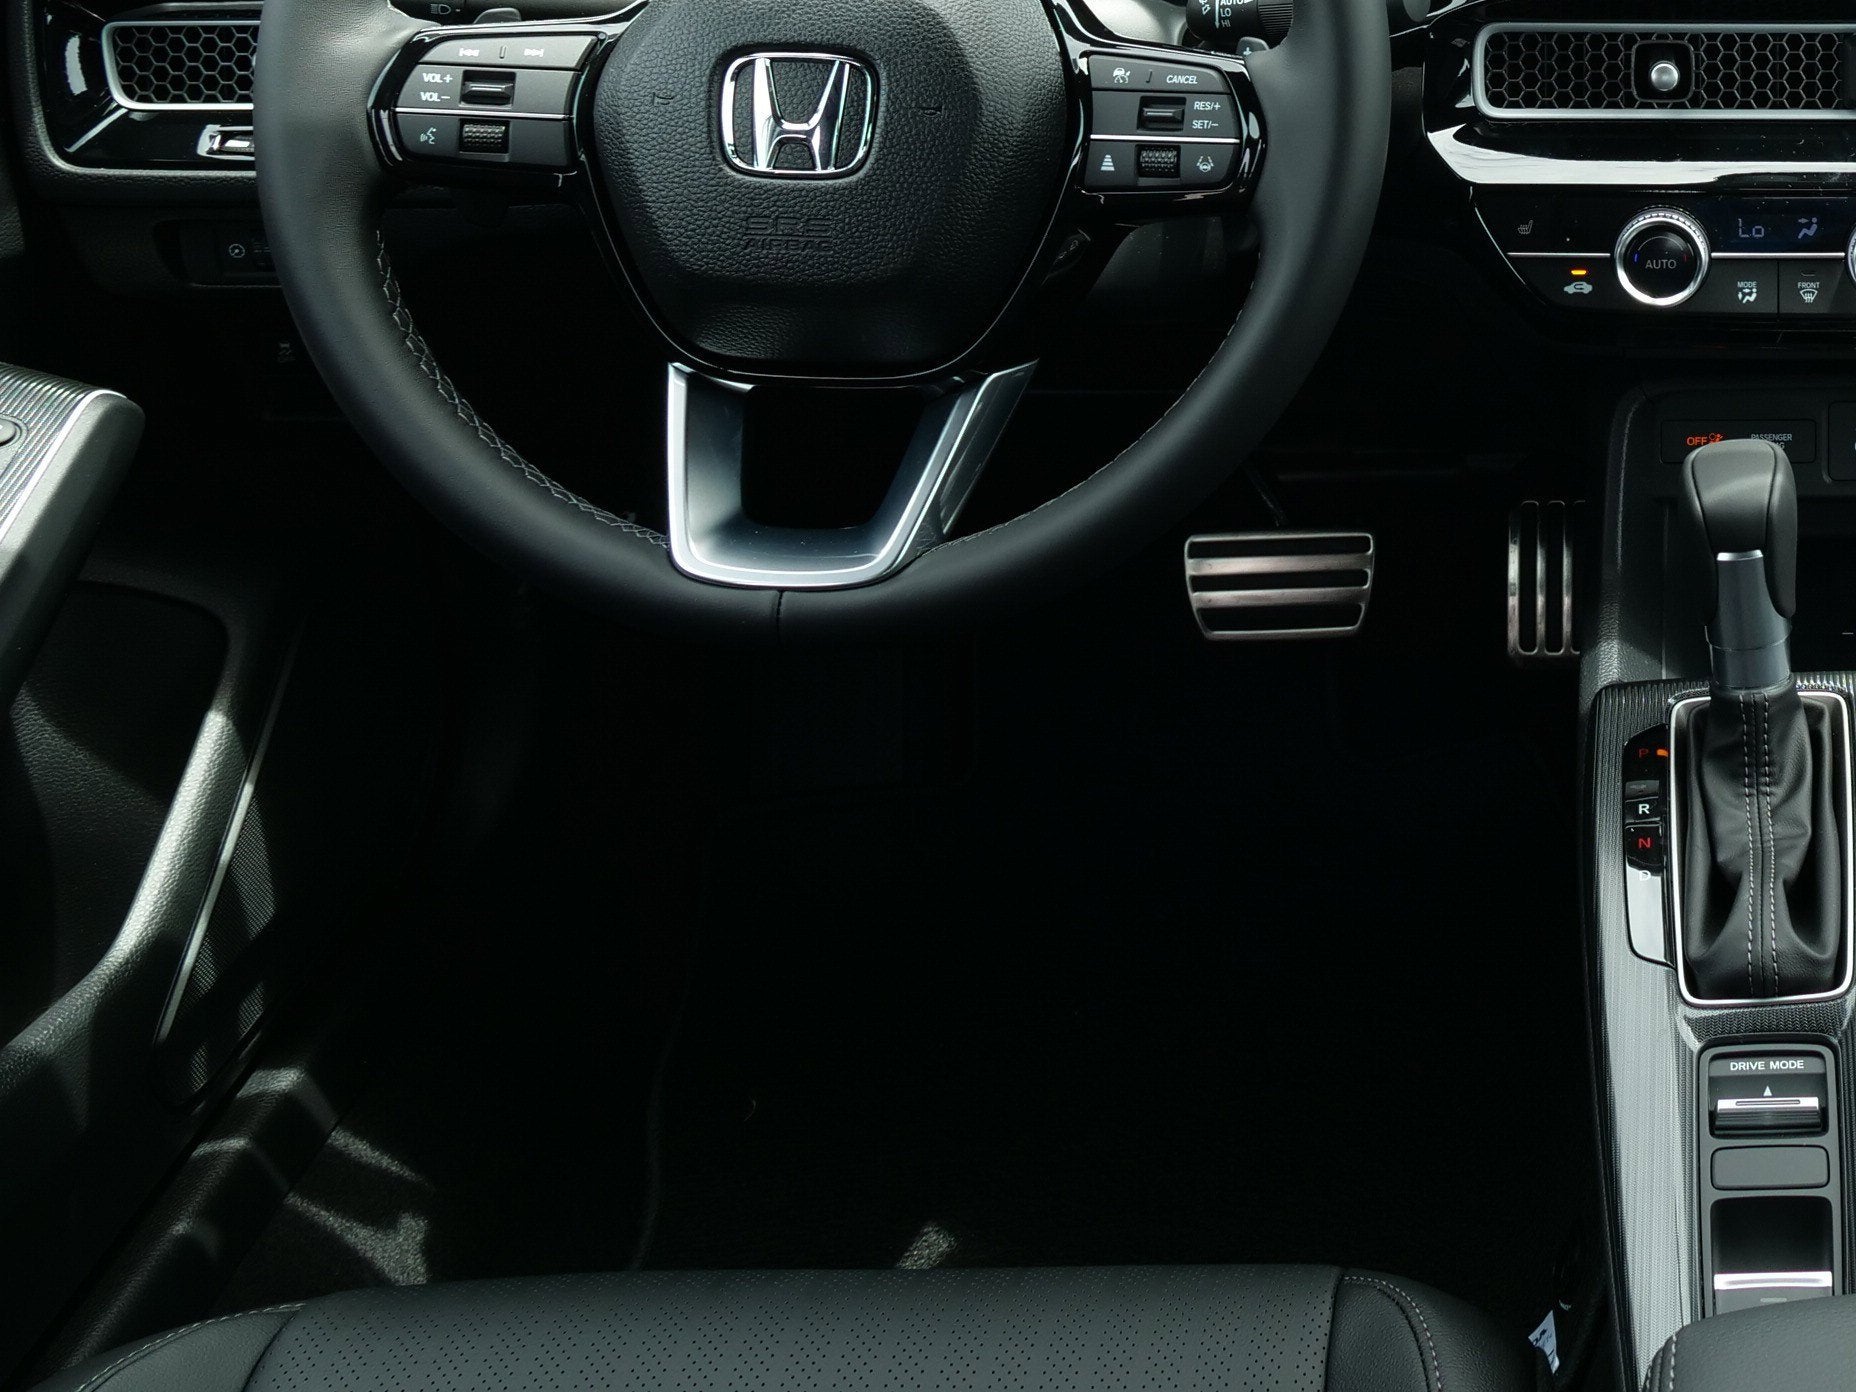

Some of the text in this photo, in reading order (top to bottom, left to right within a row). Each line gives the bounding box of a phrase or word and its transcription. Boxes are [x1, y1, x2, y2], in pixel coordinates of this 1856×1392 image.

[1221, 8, 1232, 18] LO
[1166, 74, 1198, 84] CANCEL
[1193, 101, 1221, 111] RES/+
[1738, 217, 1765, 238] Lo
[1645, 259, 1677, 270] AUTO
[1737, 281, 1758, 289] MODE
[1797, 281, 1820, 289] FRONT
[1686, 436, 1707, 446] OFF
[1750, 433, 1792, 441] PASSENGER
[1638, 748, 1649, 759] P
[1638, 803, 1650, 815] R
[1638, 837, 1651, 849] N
[1639, 870, 1652, 882] D
[1730, 1060, 1805, 1071] DRIVE MODE
